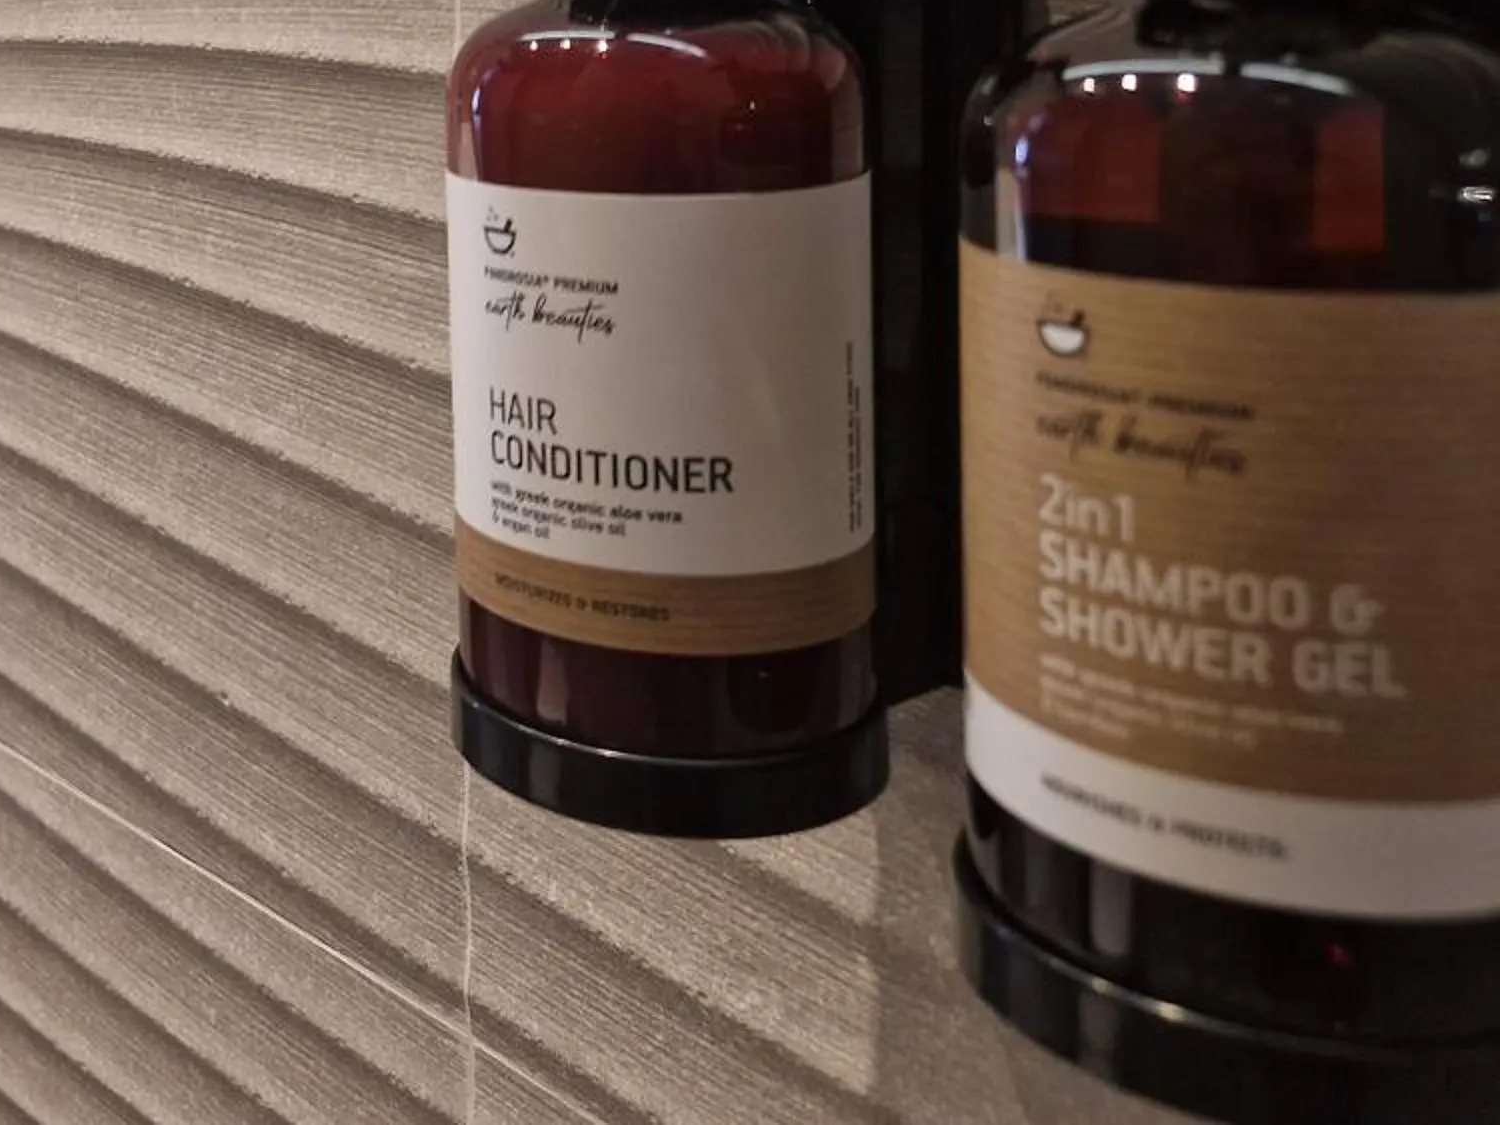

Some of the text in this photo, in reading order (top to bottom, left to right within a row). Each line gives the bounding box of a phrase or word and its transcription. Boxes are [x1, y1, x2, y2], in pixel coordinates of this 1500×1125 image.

[553, 276, 619, 295] PREMIUM
[489, 386, 557, 435] HAIR
[491, 430, 734, 493] CONDITIONER
[609, 505, 642, 521] aloe
[647, 510, 683, 523] vera
[1039, 473, 1135, 543] 2in1
[1039, 531, 1384, 636] SHAMPOO &
[1039, 587, 1273, 688] SHOWER
[1292, 639, 1408, 699] GEL
